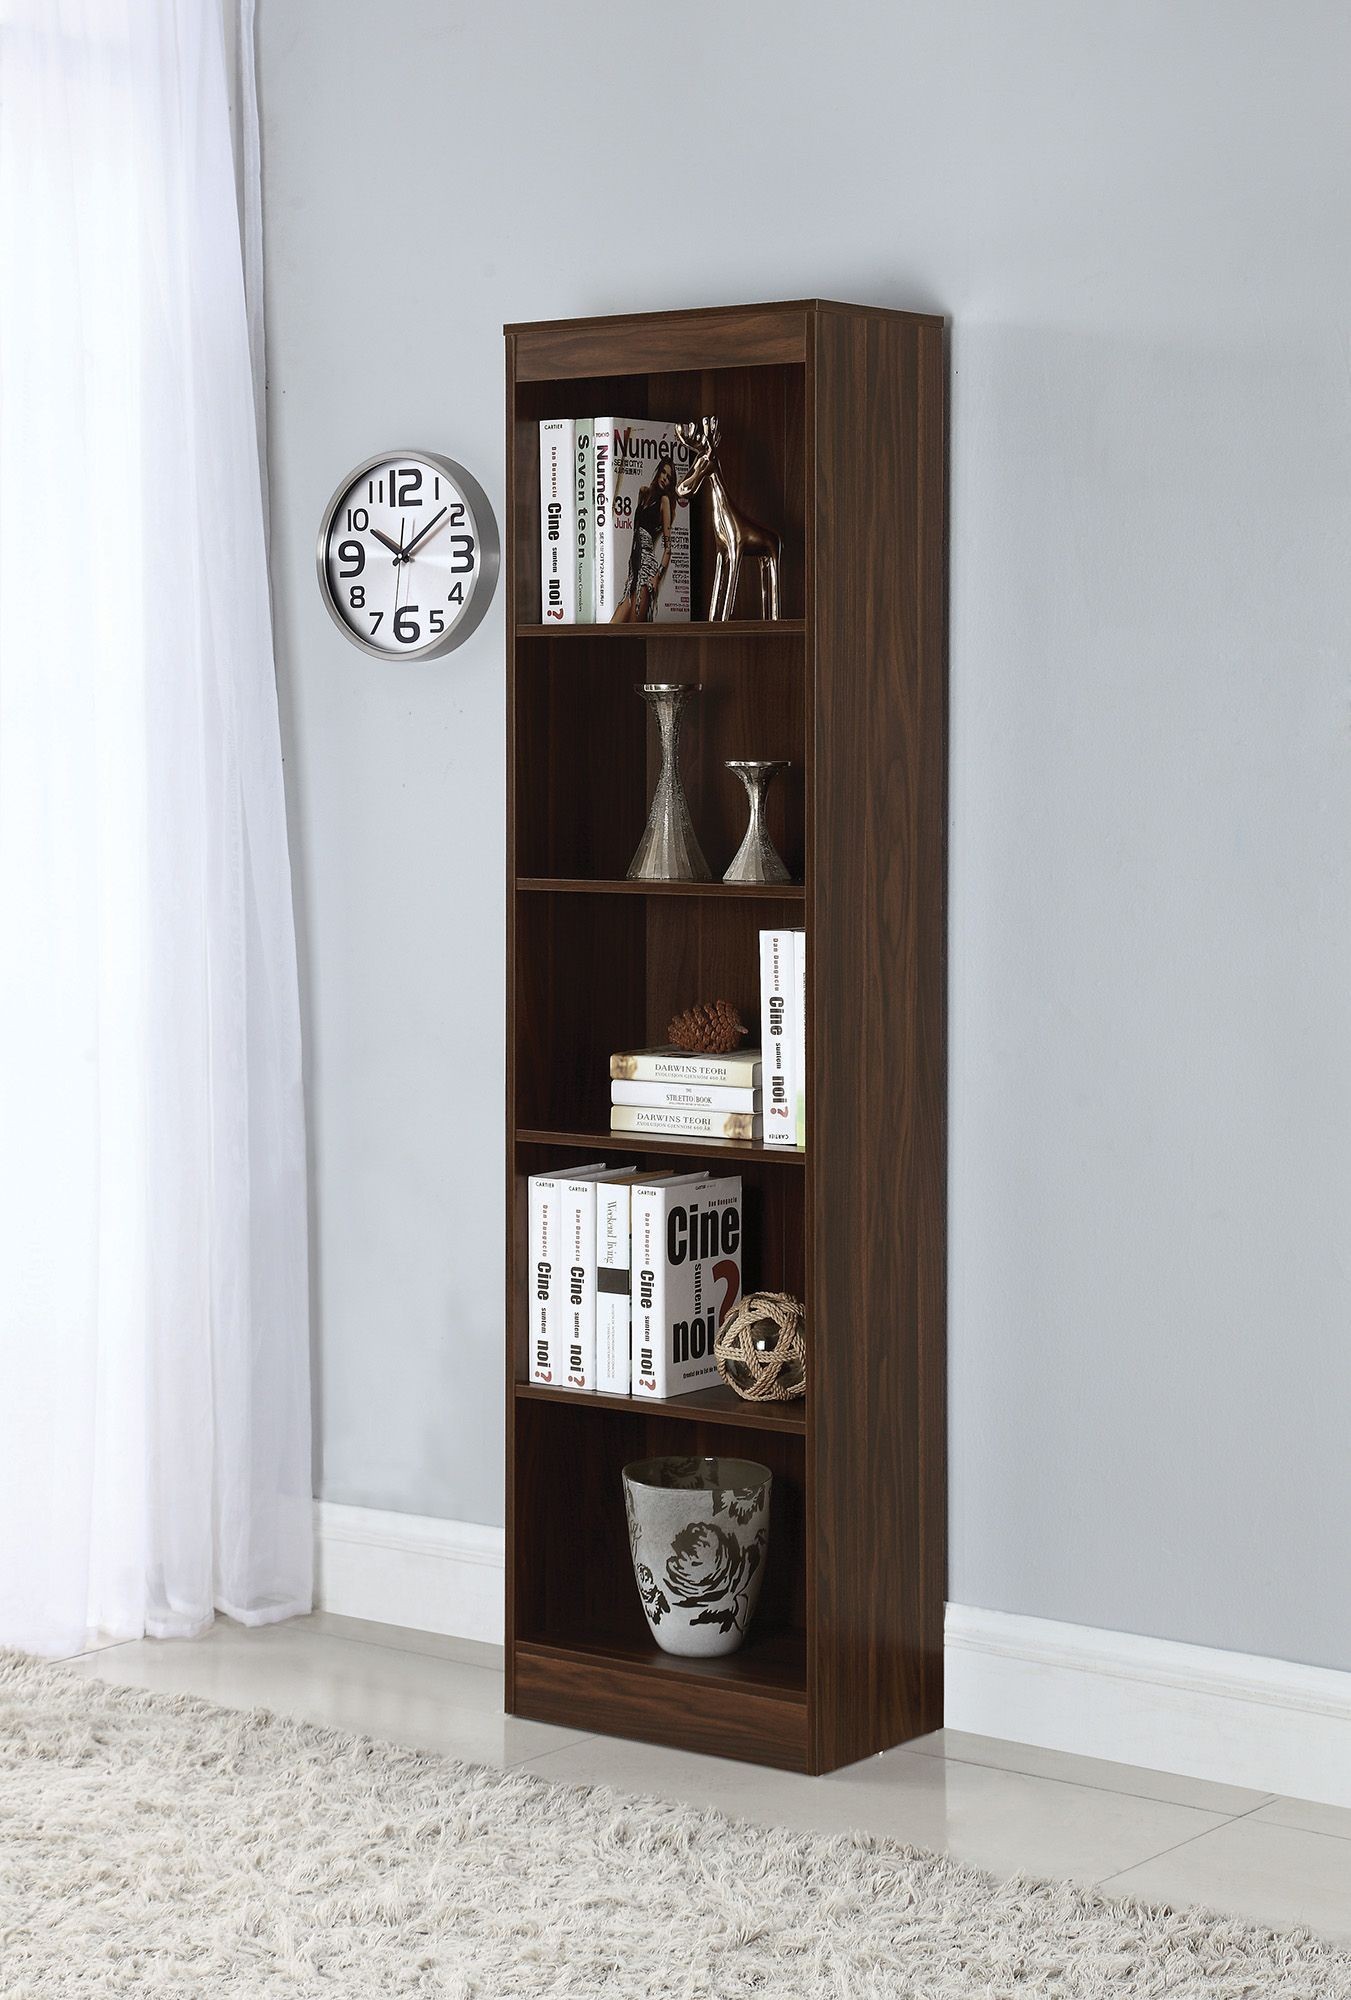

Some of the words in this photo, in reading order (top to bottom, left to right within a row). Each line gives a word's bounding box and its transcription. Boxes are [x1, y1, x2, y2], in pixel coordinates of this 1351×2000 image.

[613, 427, 688, 462] Numéro
[369, 480, 383, 504] 11
[389, 468, 423, 507] 12
[435, 477, 439, 500] 1
[596, 444, 609, 527] Numéro
[347, 508, 369, 532] 10
[450, 503, 465, 526] 2
[614, 496, 632, 516] 38
[547, 502, 562, 541] Cine
[614, 517, 633, 530] Junk
[338, 539, 366, 578] 9
[450, 534, 475, 574] 3
[350, 585, 365, 609] 8
[447, 581, 464, 605] 4
[369, 611, 384, 635] 7
[394, 605, 420, 644] 6
[429, 609, 444, 633] 5
[769, 996, 784, 1036] Cine
[655, 1063, 697, 1073] DARWINS
[699, 1067, 727, 1075] TEORI
[666, 1094, 694, 1103] STILETTO
[696, 1096, 713, 1104] BOOK
[637, 1112, 681, 1123] DARWINS
[683, 1116, 711, 1125] TEORI
[606, 1201, 617, 1238] Weekend
[667, 1204, 740, 1266] Cine
[606, 1241, 617, 1264] living
[537, 1262, 551, 1301] Cine
[570, 1266, 584, 1305] Cine
[640, 1270, 654, 1309] Cine
[694, 1262, 702, 1315] suntem
